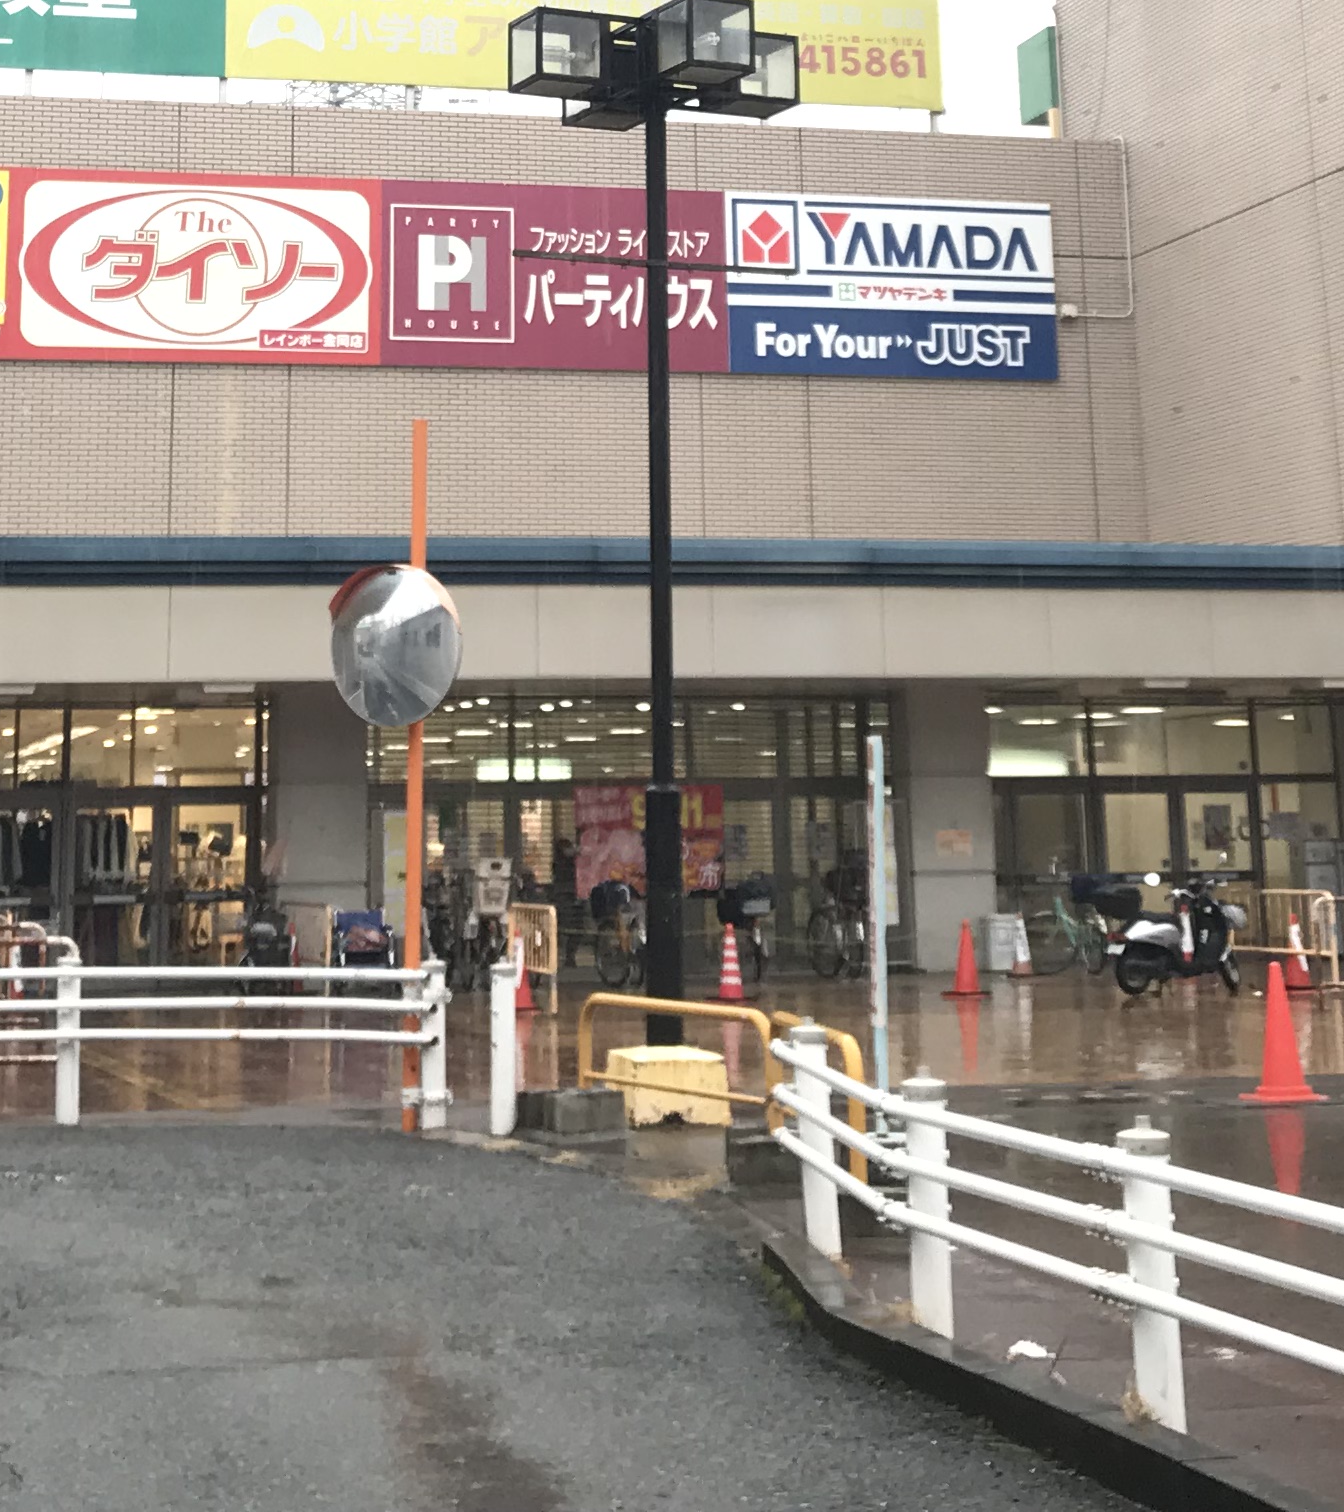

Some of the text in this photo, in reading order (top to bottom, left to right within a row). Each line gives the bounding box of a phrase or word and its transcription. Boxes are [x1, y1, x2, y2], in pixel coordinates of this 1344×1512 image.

[799, 44, 927, 79] 415861
[174, 210, 233, 234] The
[405, 216, 500, 230] PARTY
[530, 227, 710, 259] ファッション ライストア
[806, 211, 1039, 272] YAMADA
[81, 229, 339, 305] ダイソー
[857, 285, 948, 302] マツヤデンキ
[404, 318, 501, 332] HOUSE
[755, 322, 1031, 367] For Your JUST
